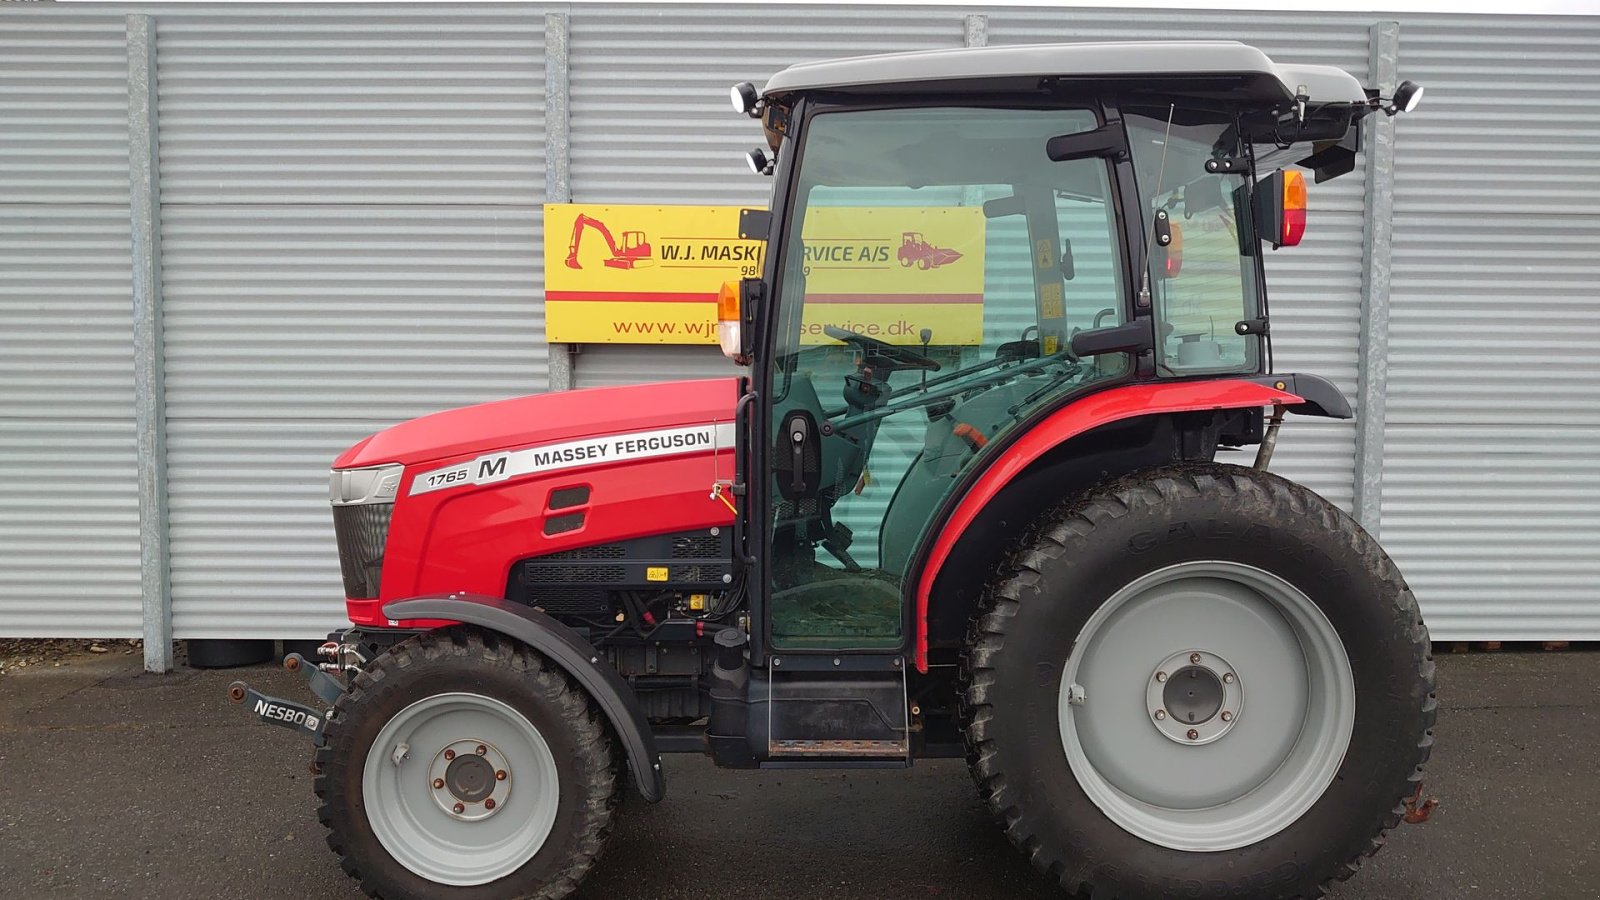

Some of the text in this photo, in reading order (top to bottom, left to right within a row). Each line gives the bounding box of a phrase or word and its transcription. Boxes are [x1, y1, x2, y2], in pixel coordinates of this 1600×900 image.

[661, 245, 695, 260] W.J.
[858, 246, 890, 262] A/S
[427, 431, 710, 486] 1765 M MASSEY FERGUSON
[254, 699, 306, 725] NESBO
